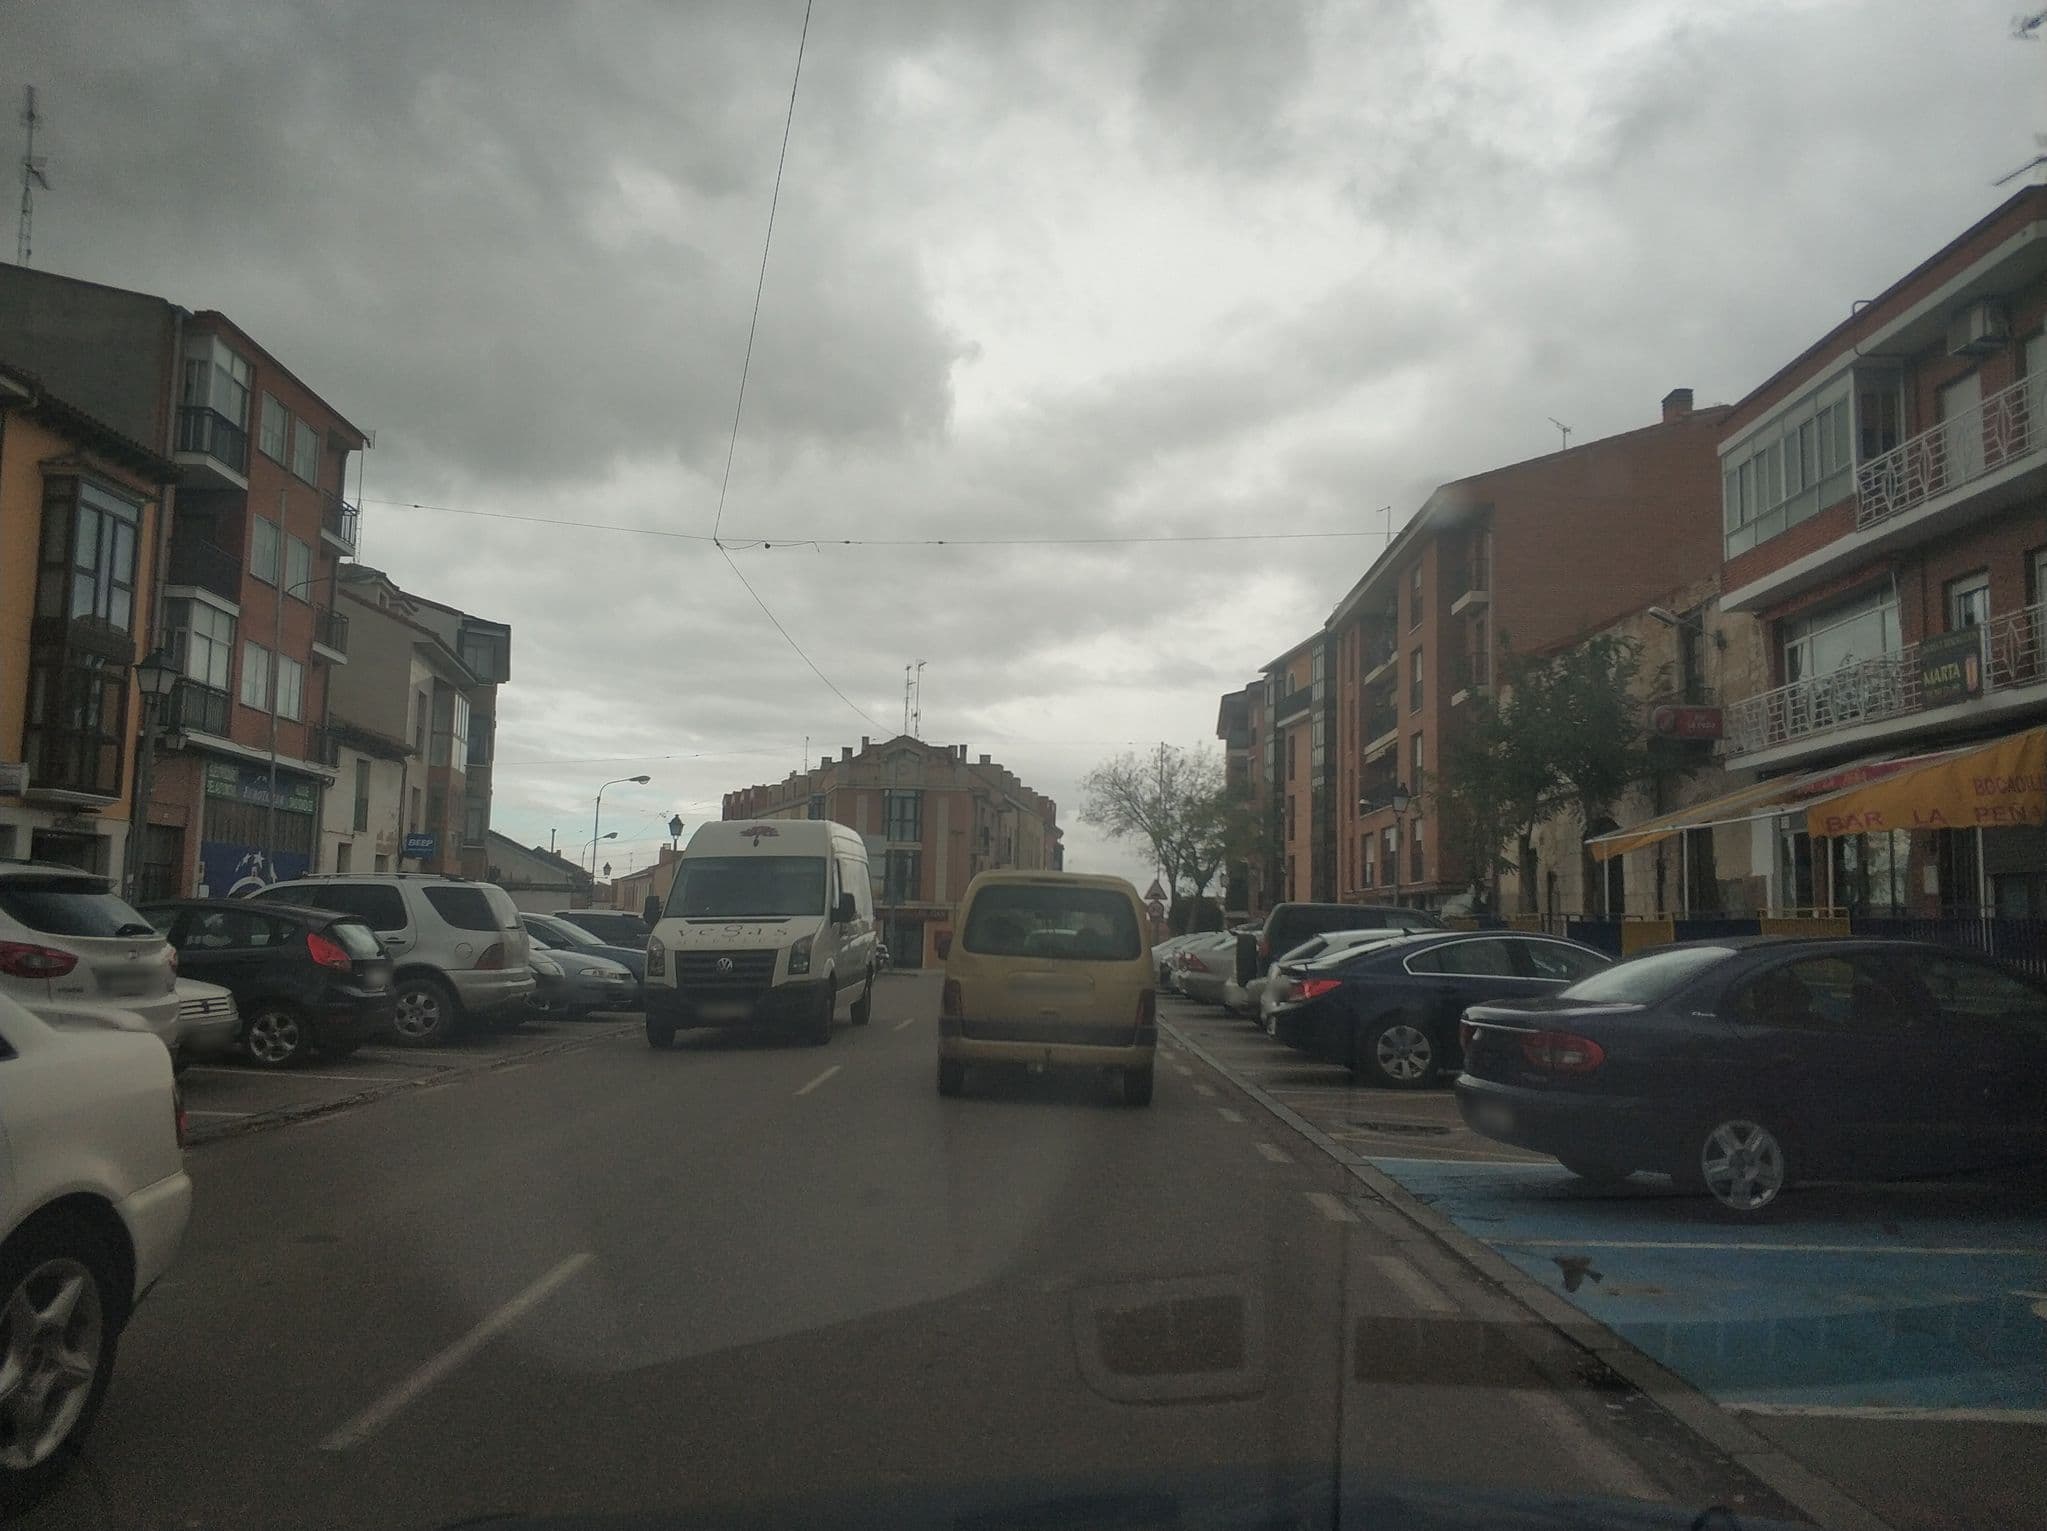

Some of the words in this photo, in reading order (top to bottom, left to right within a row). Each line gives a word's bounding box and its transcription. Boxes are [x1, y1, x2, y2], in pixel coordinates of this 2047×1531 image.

[1922, 662, 1960, 688] MARTA
[1825, 811, 1884, 832] BAR
[1912, 808, 1950, 825] LA
[408, 838, 433, 847] BEEP
